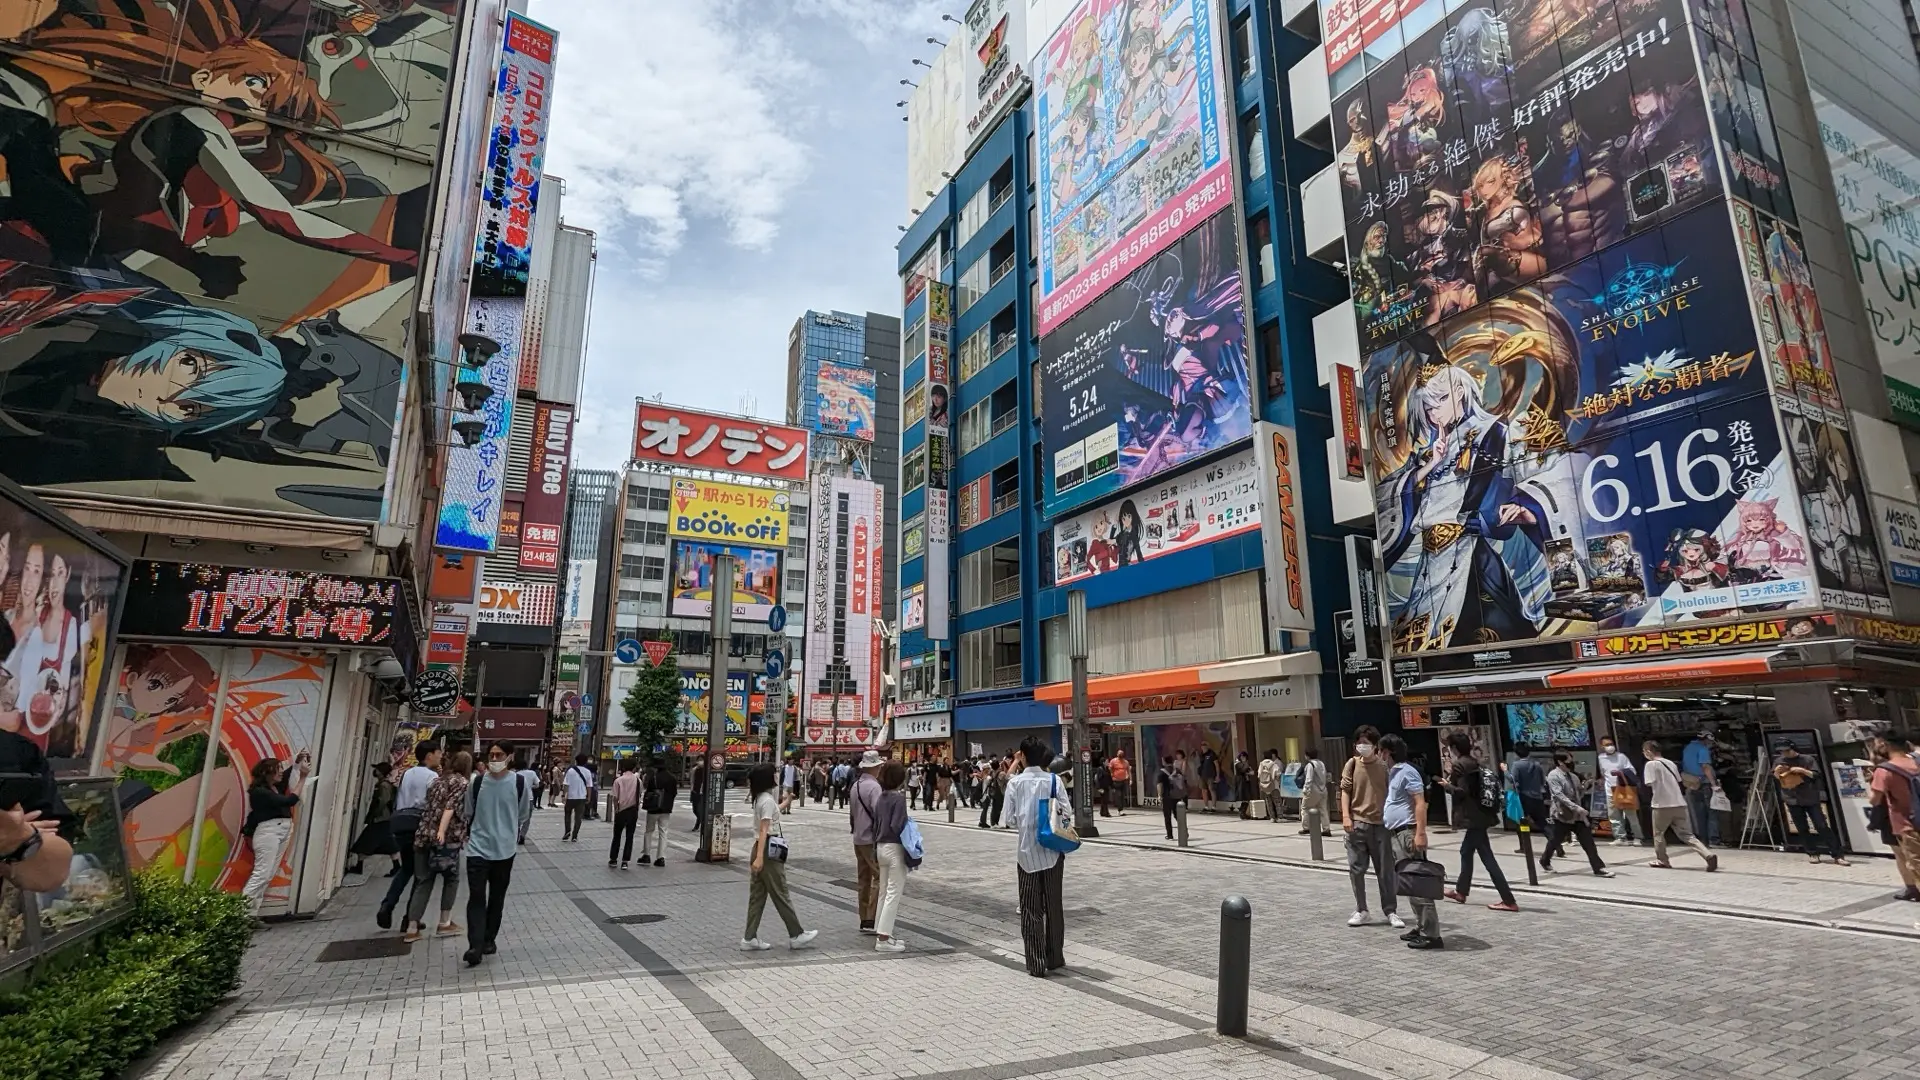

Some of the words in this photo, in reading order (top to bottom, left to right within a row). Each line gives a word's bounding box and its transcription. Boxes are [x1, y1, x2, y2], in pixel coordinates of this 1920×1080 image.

[511, 29, 549, 51] エスパス
[1511, 17, 1671, 132] 好評発売中!
[966, 62, 1024, 135] TAKARADA
[1581, 276, 1701, 329] SHADOWVERSE
[1371, 310, 1424, 339] EVOLVE
[1591, 296, 1691, 343] EVOLVE
[1046, 319, 1121, 374] ソードアート・オンライン
[1583, 351, 1734, 418] 絶対なる覇者
[1069, 385, 1097, 417] 5.24
[535, 408, 548, 446] Flagship
[545, 410, 571, 447] Duty
[641, 417, 804, 470] オノデン
[532, 446, 545, 473] Store
[542, 453, 566, 495] Free
[1582, 428, 1732, 523] 6.16
[703, 487, 769, 509] 駅から1分
[526, 527, 556, 541] 免税
[874, 513, 882, 544] GOODS
[1272, 431, 1306, 620] GAMERS
[523, 549, 555, 563] 면세점
[854, 531, 866, 611] ラブメルシー
[873, 556, 882, 578] LOVE
[873, 578, 881, 605] MERCI
[1678, 594, 1728, 609] hololive
[1738, 581, 1807, 598] コラボ決定!
[432, 622, 466, 631] フロア案内
[497, 611, 520, 619] Store
[1628, 621, 1781, 652] カードキングダム
[415, 670, 457, 688] SMOKER'S
[1356, 678, 1370, 689] 2F
[1128, 690, 1221, 713] GAMERS
